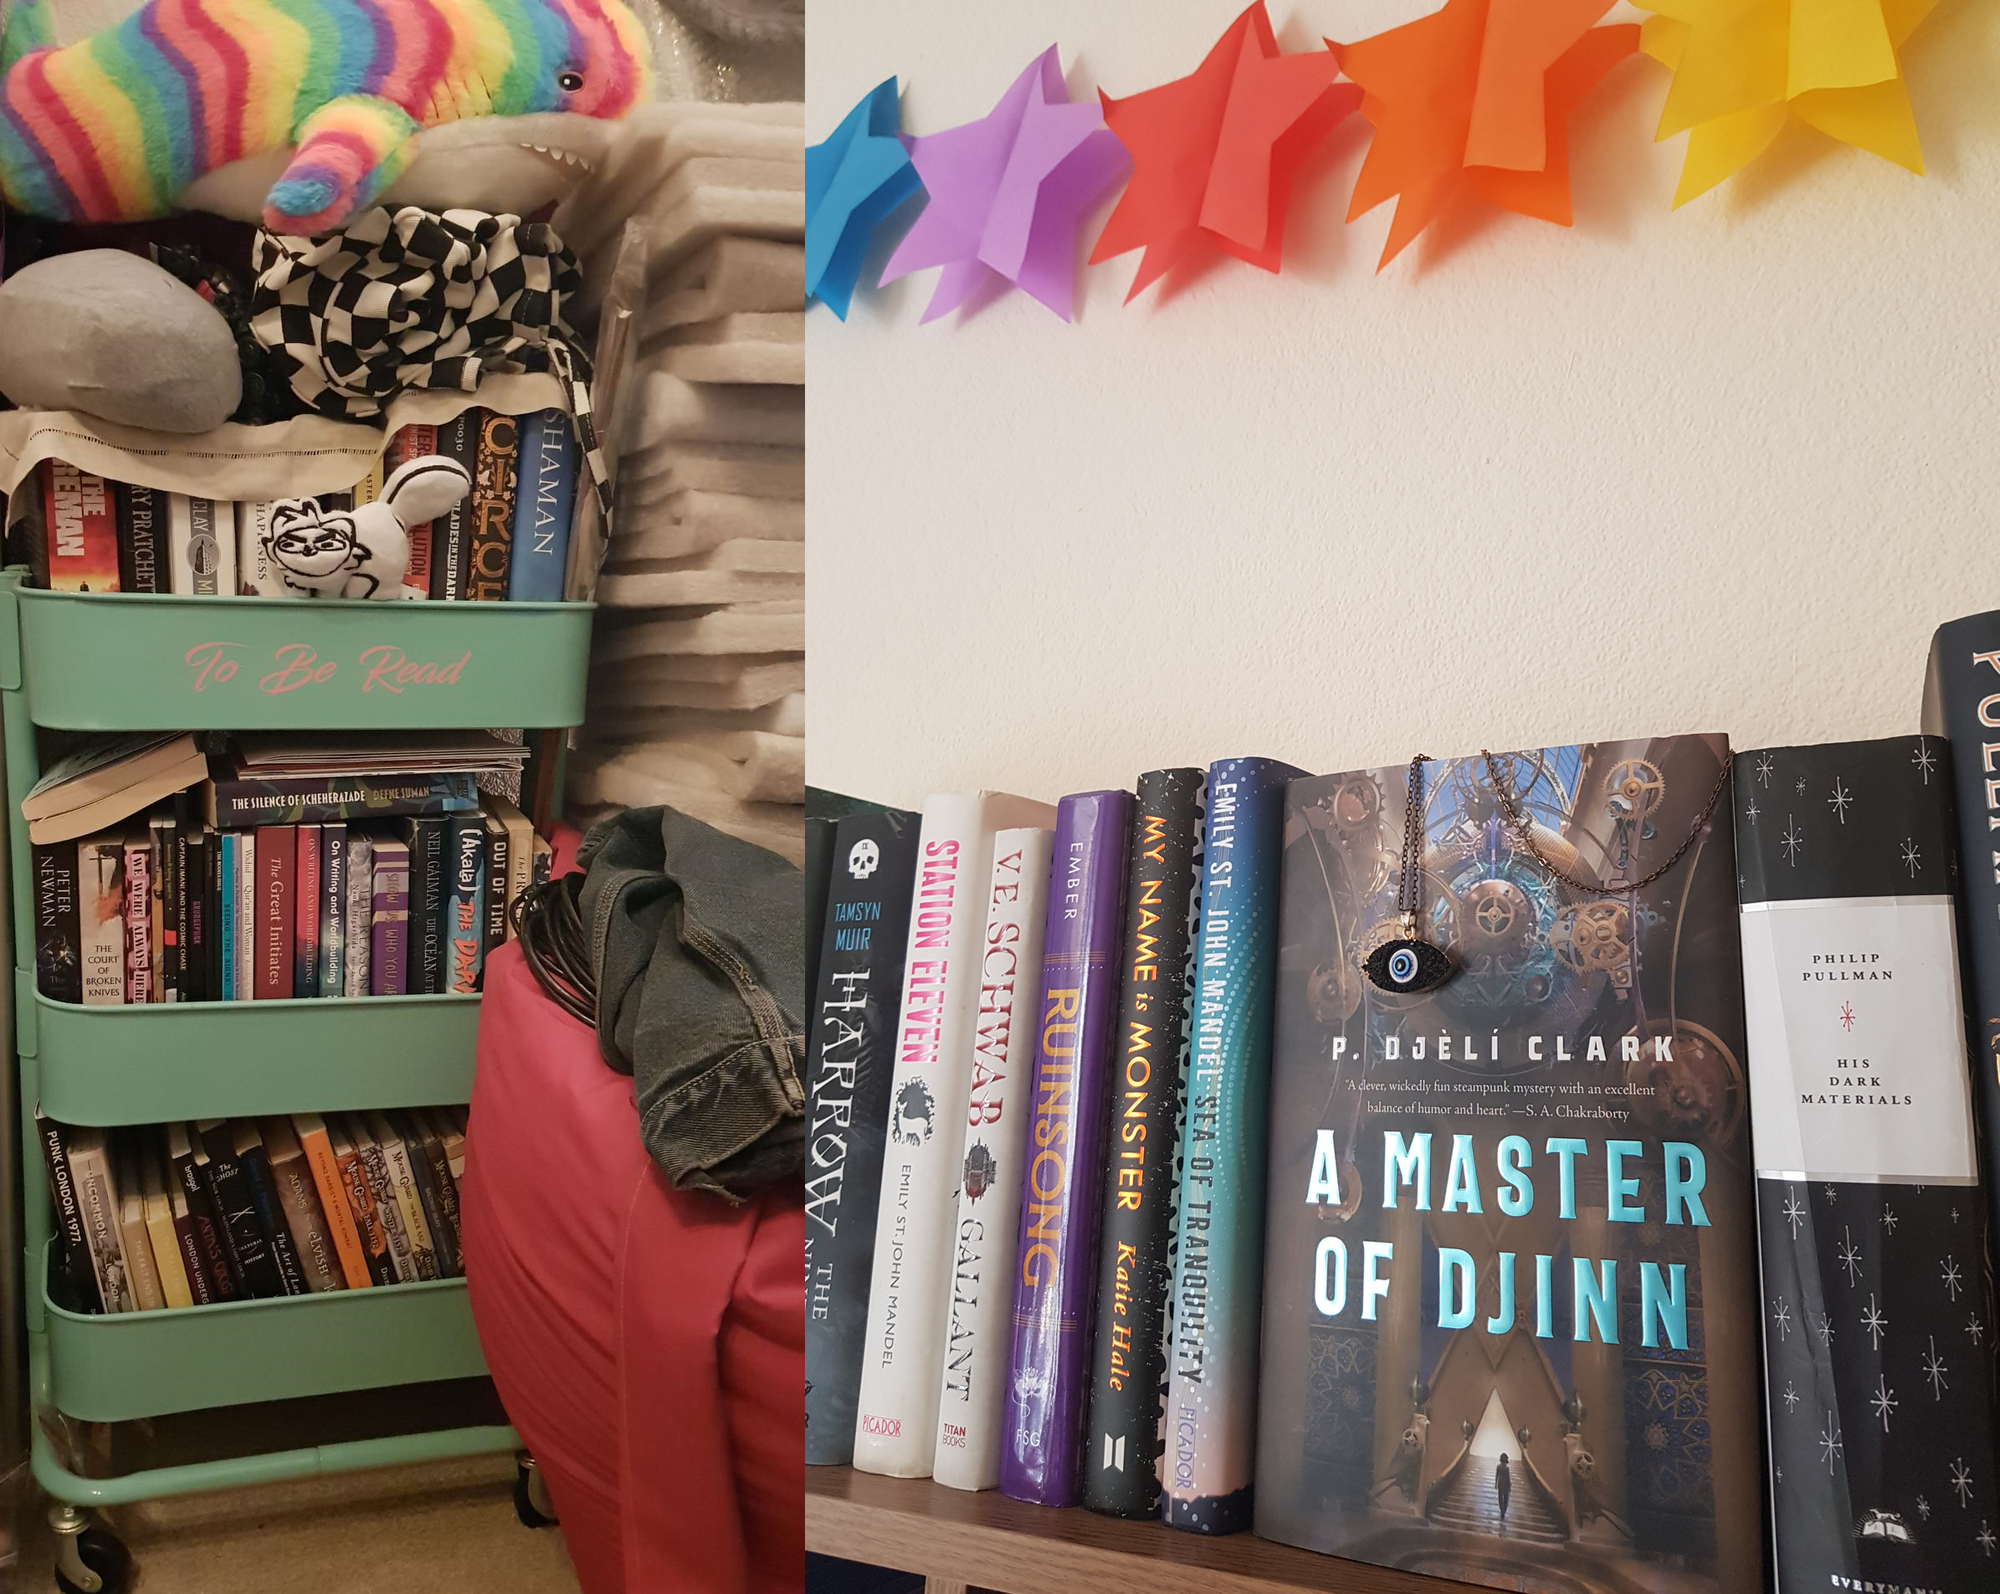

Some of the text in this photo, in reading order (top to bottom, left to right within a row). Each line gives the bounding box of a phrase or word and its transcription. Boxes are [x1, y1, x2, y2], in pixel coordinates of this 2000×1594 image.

[82, 476, 106, 516] THE
[533, 410, 565, 555] SHAMAN
[185, 642, 472, 695] To Be Read
[232, 790, 366, 810] THE SILENCE OF SCHEHERAZADE
[373, 786, 430, 801] DEFNE SUMAN
[178, 837, 186, 867] CAPTAIN
[309, 838, 316, 851] ON
[331, 840, 341, 856] On
[133, 857, 144, 876] WE
[308, 853, 316, 891] WRITING
[329, 858, 341, 893] Writing
[426, 831, 441, 911] NEIL GAIMAN
[1064, 842, 1083, 920] EMBER
[40, 856, 56, 927] NEWMAN
[56, 870, 71, 913] PETER
[133, 882, 145, 916] WERE
[329, 896, 340, 915] and
[385, 873, 399, 904] SHOW
[490, 842, 507, 936] OUT OF TIME
[269, 858, 284, 985] The Great Initiates
[458, 900, 476, 931] THE
[835, 902, 881, 922] TAMSYN
[95, 945, 112, 953] THE
[134, 924, 146, 967] ALWAYS
[305, 912, 314, 983] WORLDBUILDING
[327, 917, 340, 984] Worldbuilding
[357, 889, 371, 991] THE REASON
[385, 930, 399, 953] WHO
[424, 934, 441, 971] OCEAN
[836, 927, 871, 951] MUIR
[902, 840, 960, 1063] STATION ELEVEN
[88, 956, 119, 964] COURT
[97, 967, 110, 975] OF
[384, 957, 398, 979] YOU
[1813, 953, 1880, 964] PHILIP
[86, 977, 122, 986] BROKEN
[88, 989, 120, 997] KNIVES
[1802, 971, 1893, 982] PULLMAN
[969, 922, 1021, 1127] SCHWAB
[1332, 1029, 1674, 1062] P. DJÈLÍ CLARK
[1837, 1058, 1870, 1068] HIS
[1178, 782, 1238, 1384] EMILY ST. JOHN MANDEL SEA OF TRANQUILITY
[1358, 1080, 1387, 1092] clever,
[1389, 1080, 1432, 1095] wickedly
[1433, 1080, 1451, 1092] fun
[1453, 1080, 1510, 1096] steampunk
[1513, 1084, 1556, 1097] mystery
[1559, 1081, 1585, 1094] with
[1587, 1085, 1601, 1095] an
[1604, 1082, 1655, 1096] excellent
[1829, 1077, 1881, 1087] DARK
[1109, 815, 1167, 1393] MY NAME is MONSTER Katie Hale
[1367, 1101, 1403, 1114] balance
[1405, 1101, 1418, 1114] of
[1418, 1102, 1452, 1114] humor
[1454, 1102, 1474, 1115] and
[1540, 1105, 1552, 1117] A.
[1556, 1106, 1630, 1123] Chakraborty
[1801, 1094, 1912, 1105] MATERIALS
[805, 967, 871, 1320] HARROW THE
[1022, 988, 1080, 1287] RUINSONG
[184, 1164, 200, 1192] brosgol
[219, 1163, 231, 1172] The
[1306, 1129, 1712, 1227] A MASTER
[47, 1130, 82, 1247] PUNK LONDON 1977.
[289, 1172, 308, 1209] ADAMS
[346, 1161, 360, 1187] MOUSE
[354, 1186, 367, 1211] GUARD
[363, 1214, 373, 1230] FALL
[184, 1234, 200, 1269] LONDON
[276, 1232, 286, 1249] The
[282, 1250, 291, 1267] Art
[288, 1268, 296, 1278] of
[882, 1165, 912, 1369] EMILY ST. JOHN MANDEL
[946, 1218, 985, 1402] GALLANT
[1314, 1236, 1690, 1350] OF DJINN
[863, 1416, 901, 1436] PICADOR
[942, 1435, 966, 1448] BOOKS
[944, 1423, 966, 1438] TITAN
[1016, 1428, 1041, 1447] FSG
[1176, 1406, 1195, 1489] PICADOR
